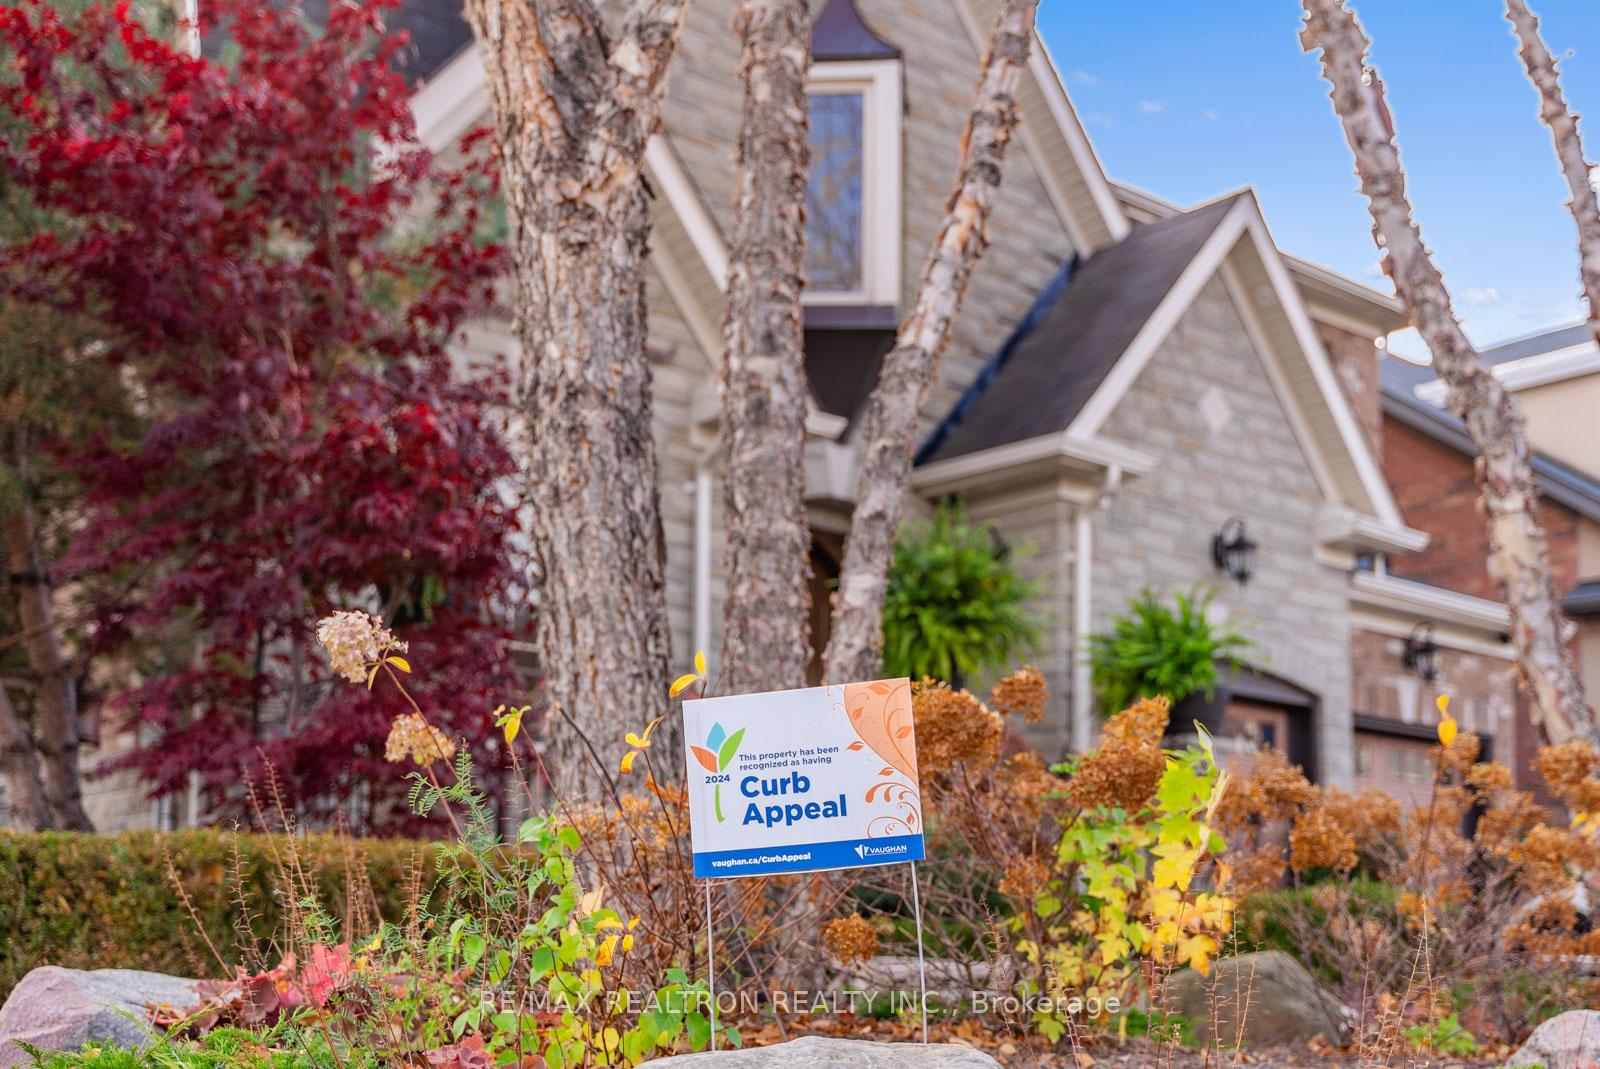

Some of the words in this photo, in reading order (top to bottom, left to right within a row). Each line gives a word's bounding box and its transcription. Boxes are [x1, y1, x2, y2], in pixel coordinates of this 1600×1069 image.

[739, 754, 757, 762] This
[759, 750, 798, 761] property
[799, 748, 815, 757] has
[816, 746, 839, 755] been
[739, 760, 788, 771] recognized
[790, 759, 800, 767] as
[802, 755, 832, 765] having
[705, 774, 731, 784] 2024
[740, 771, 811, 798] Curb
[742, 794, 848, 828] Appeal
[869, 844, 907, 855] VAUGHAN
[711, 852, 811, 868] vaughan.ca/CurbAppeal
